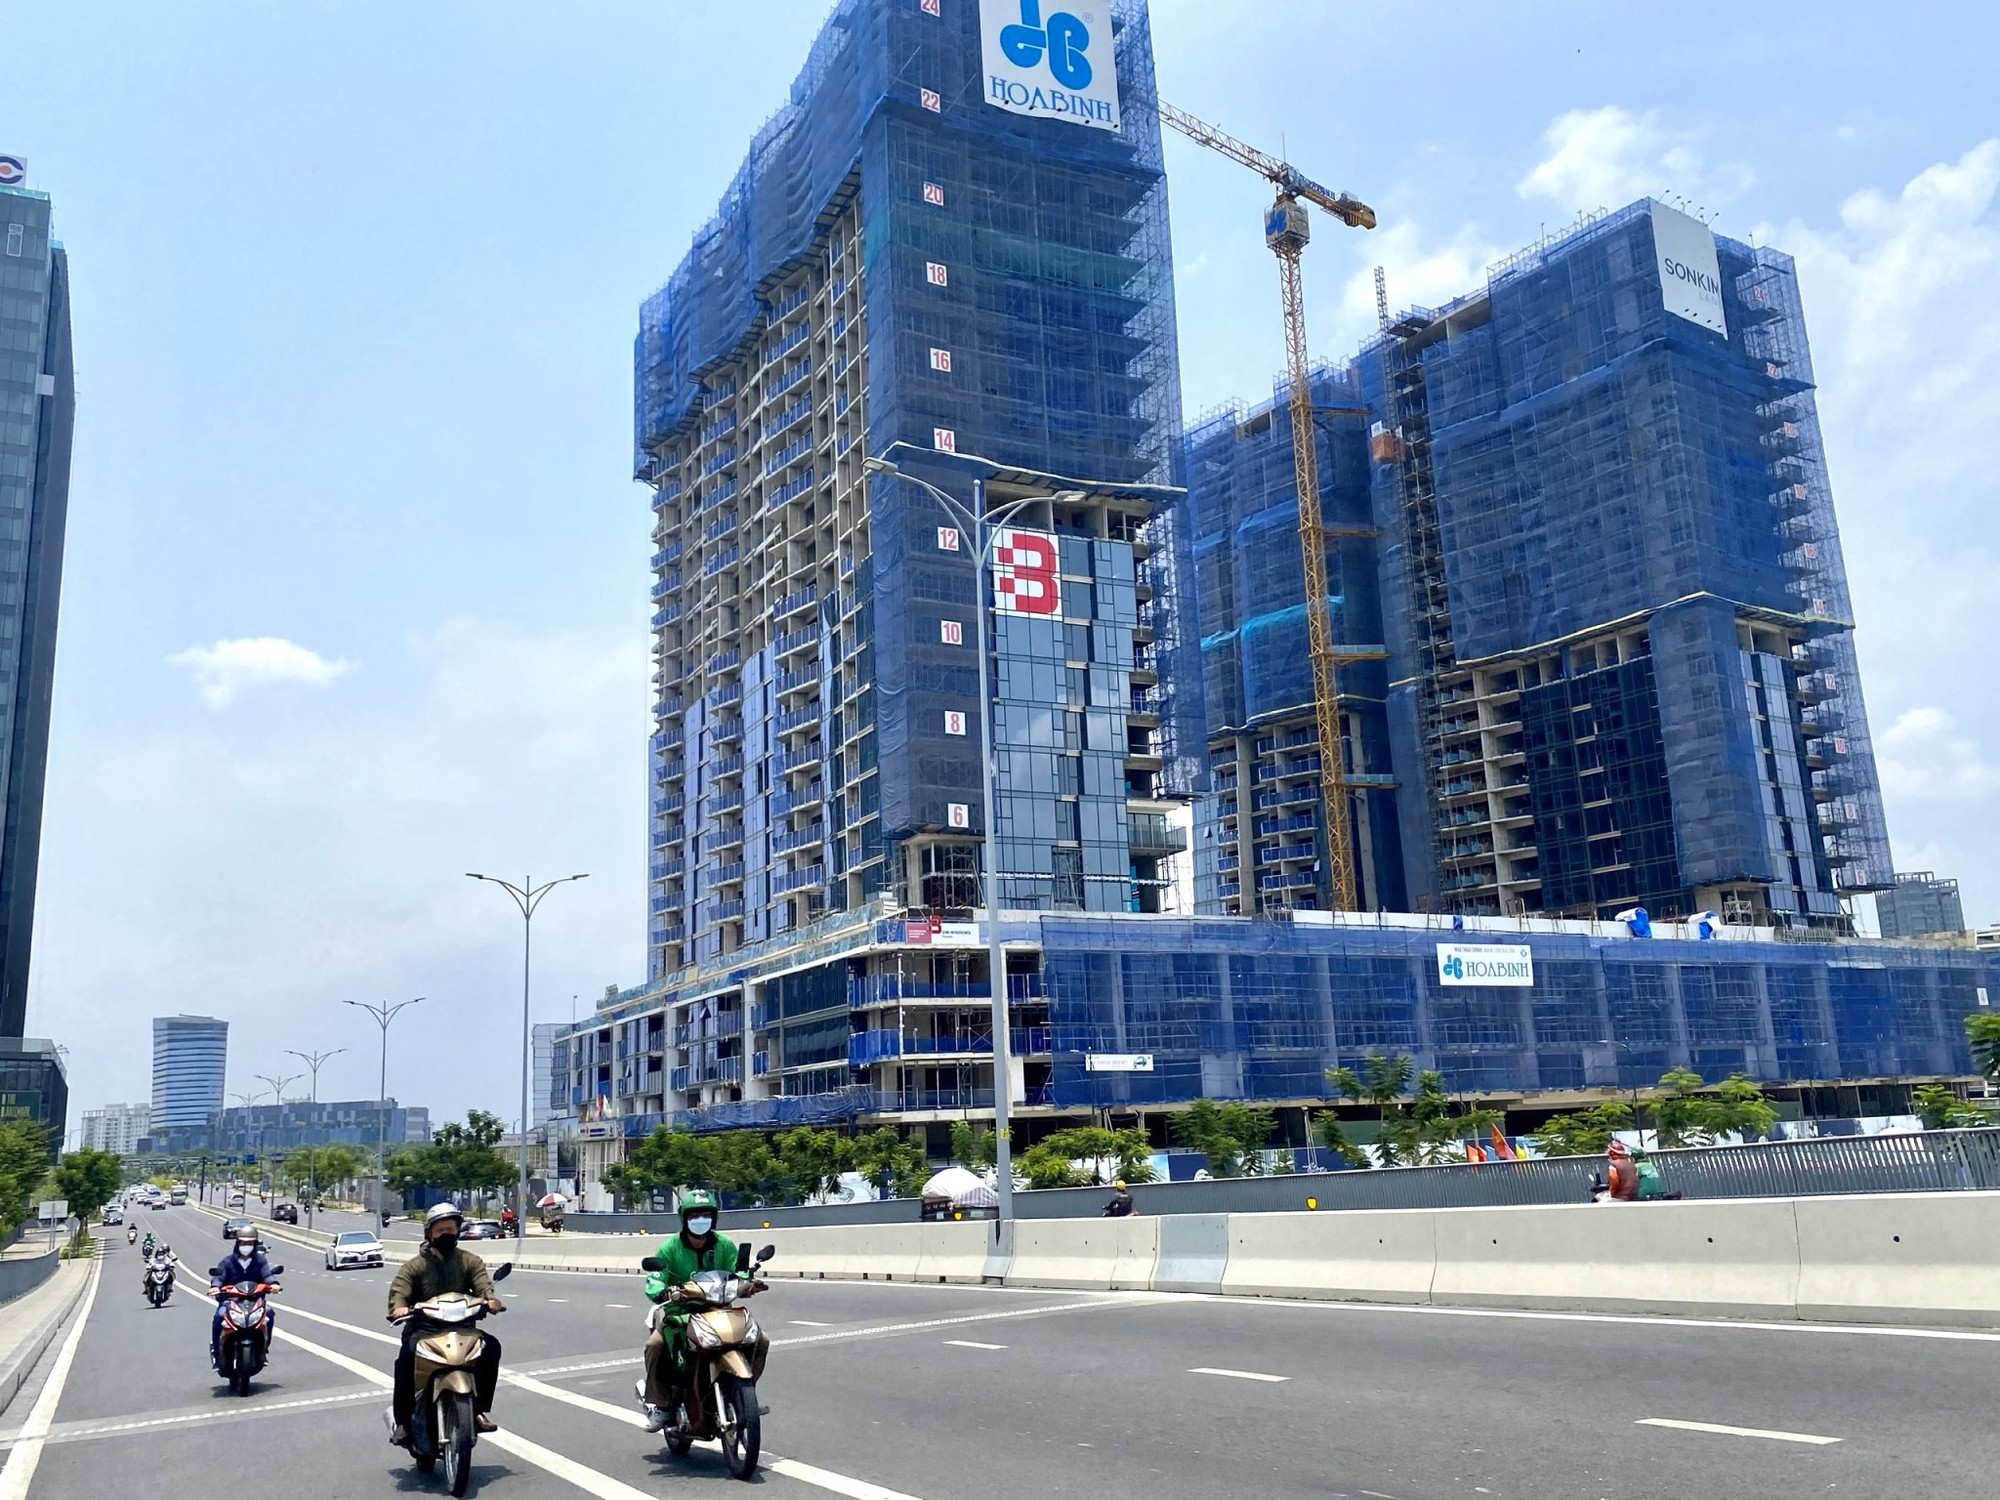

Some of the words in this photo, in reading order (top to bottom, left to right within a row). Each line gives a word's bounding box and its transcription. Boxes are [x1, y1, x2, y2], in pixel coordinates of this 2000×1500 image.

[922, 91, 940, 111] 22
[990, 76, 1114, 123] HOABINH
[925, 183, 943, 204] 20
[929, 265, 946, 285] 18
[933, 351, 950, 371] 16
[936, 431, 953, 451] 14
[940, 529, 957, 550] 12
[943, 623, 960, 643] 10
[950, 712, 961, 734] 8
[953, 805, 963, 826] 6
[1466, 961, 1529, 978] HOABINH
